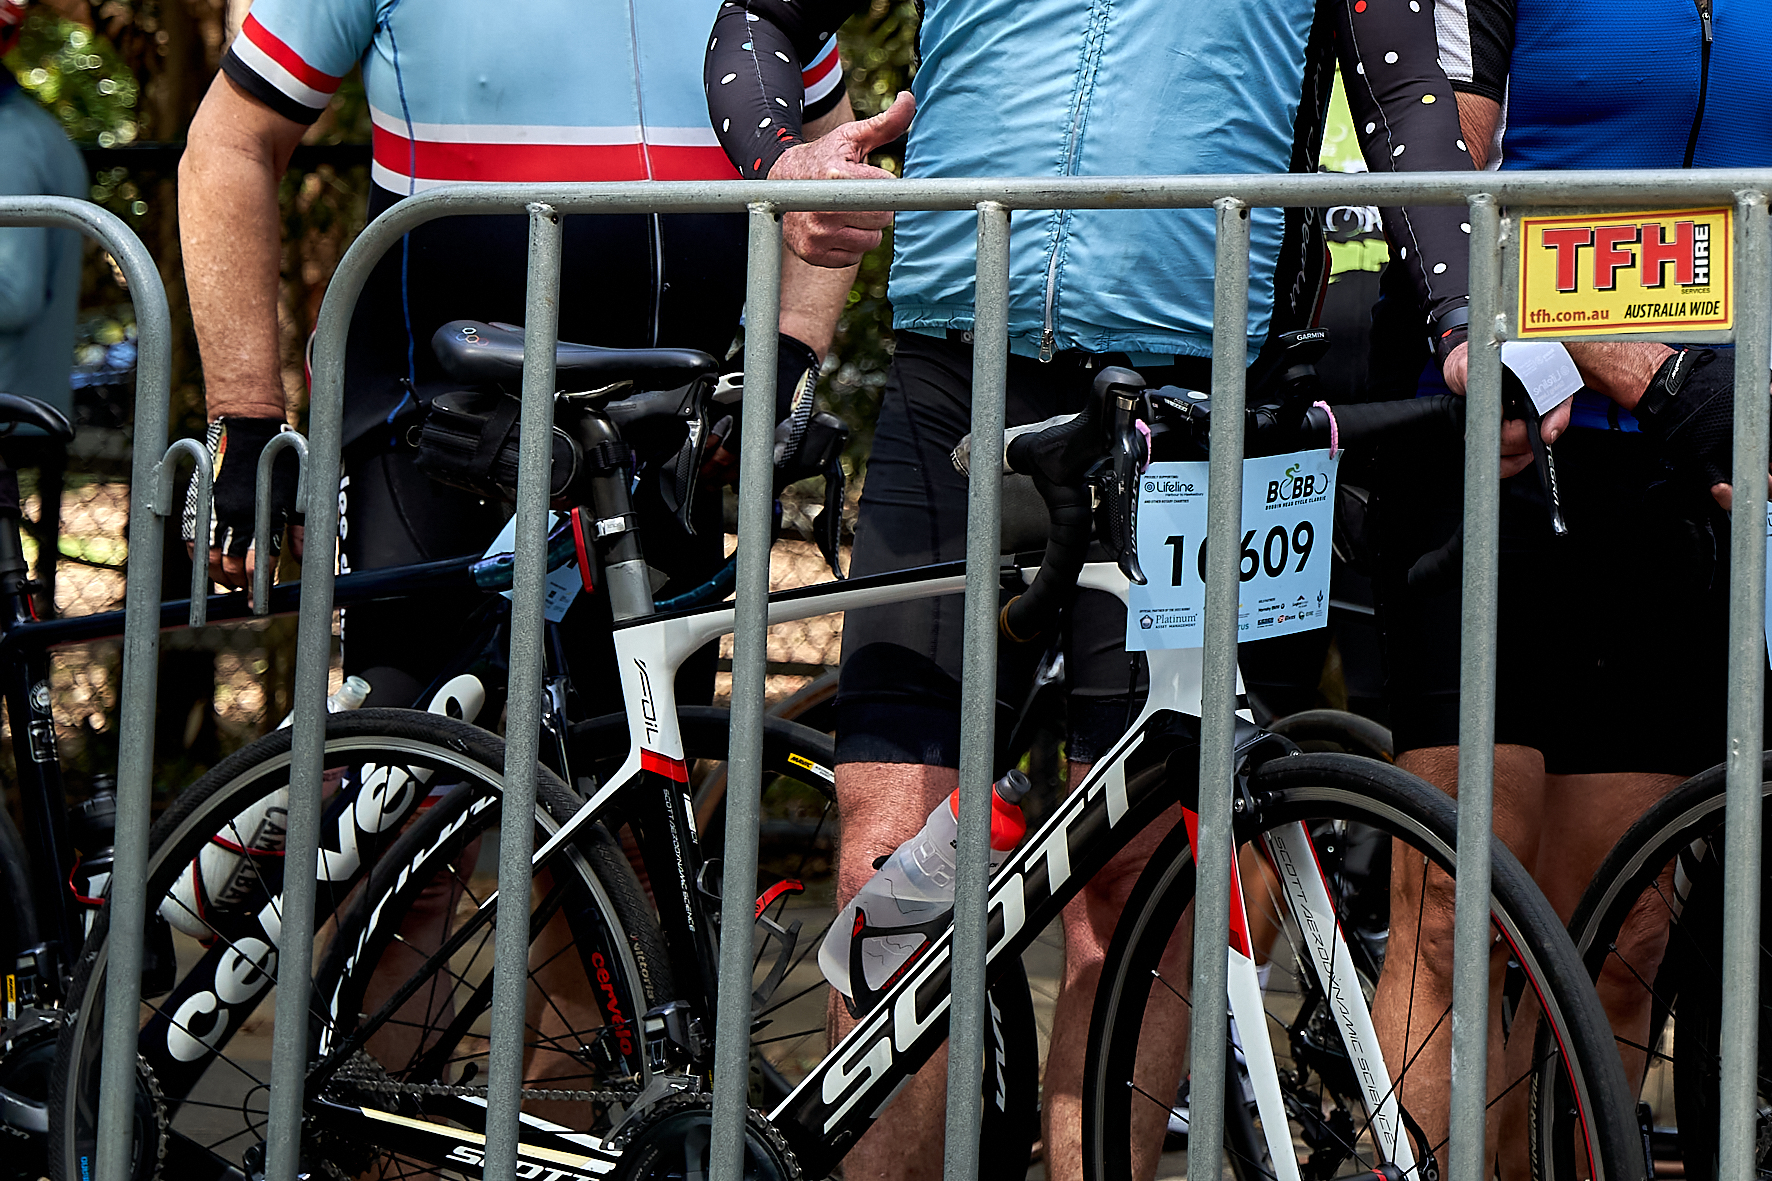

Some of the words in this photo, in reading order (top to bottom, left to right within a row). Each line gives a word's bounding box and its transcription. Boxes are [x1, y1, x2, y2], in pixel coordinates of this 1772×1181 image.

[1542, 221, 1697, 292] TFH
[1694, 225, 1709, 285] HIRE
[1681, 287, 1711, 295] SERVICES
[1529, 309, 1610, 324] tfh.com.au
[1624, 301, 1687, 320] AUSTRALIA
[1689, 300, 1721, 317] WIDE
[1296, 331, 1325, 341] GARMIN
[1157, 481, 1194, 492] Lifeline
[1156, 614, 1196, 624] Platinum
[1273, 835, 1308, 904] SCOTT
[1357, 1058, 1394, 1146] SCIENCE
